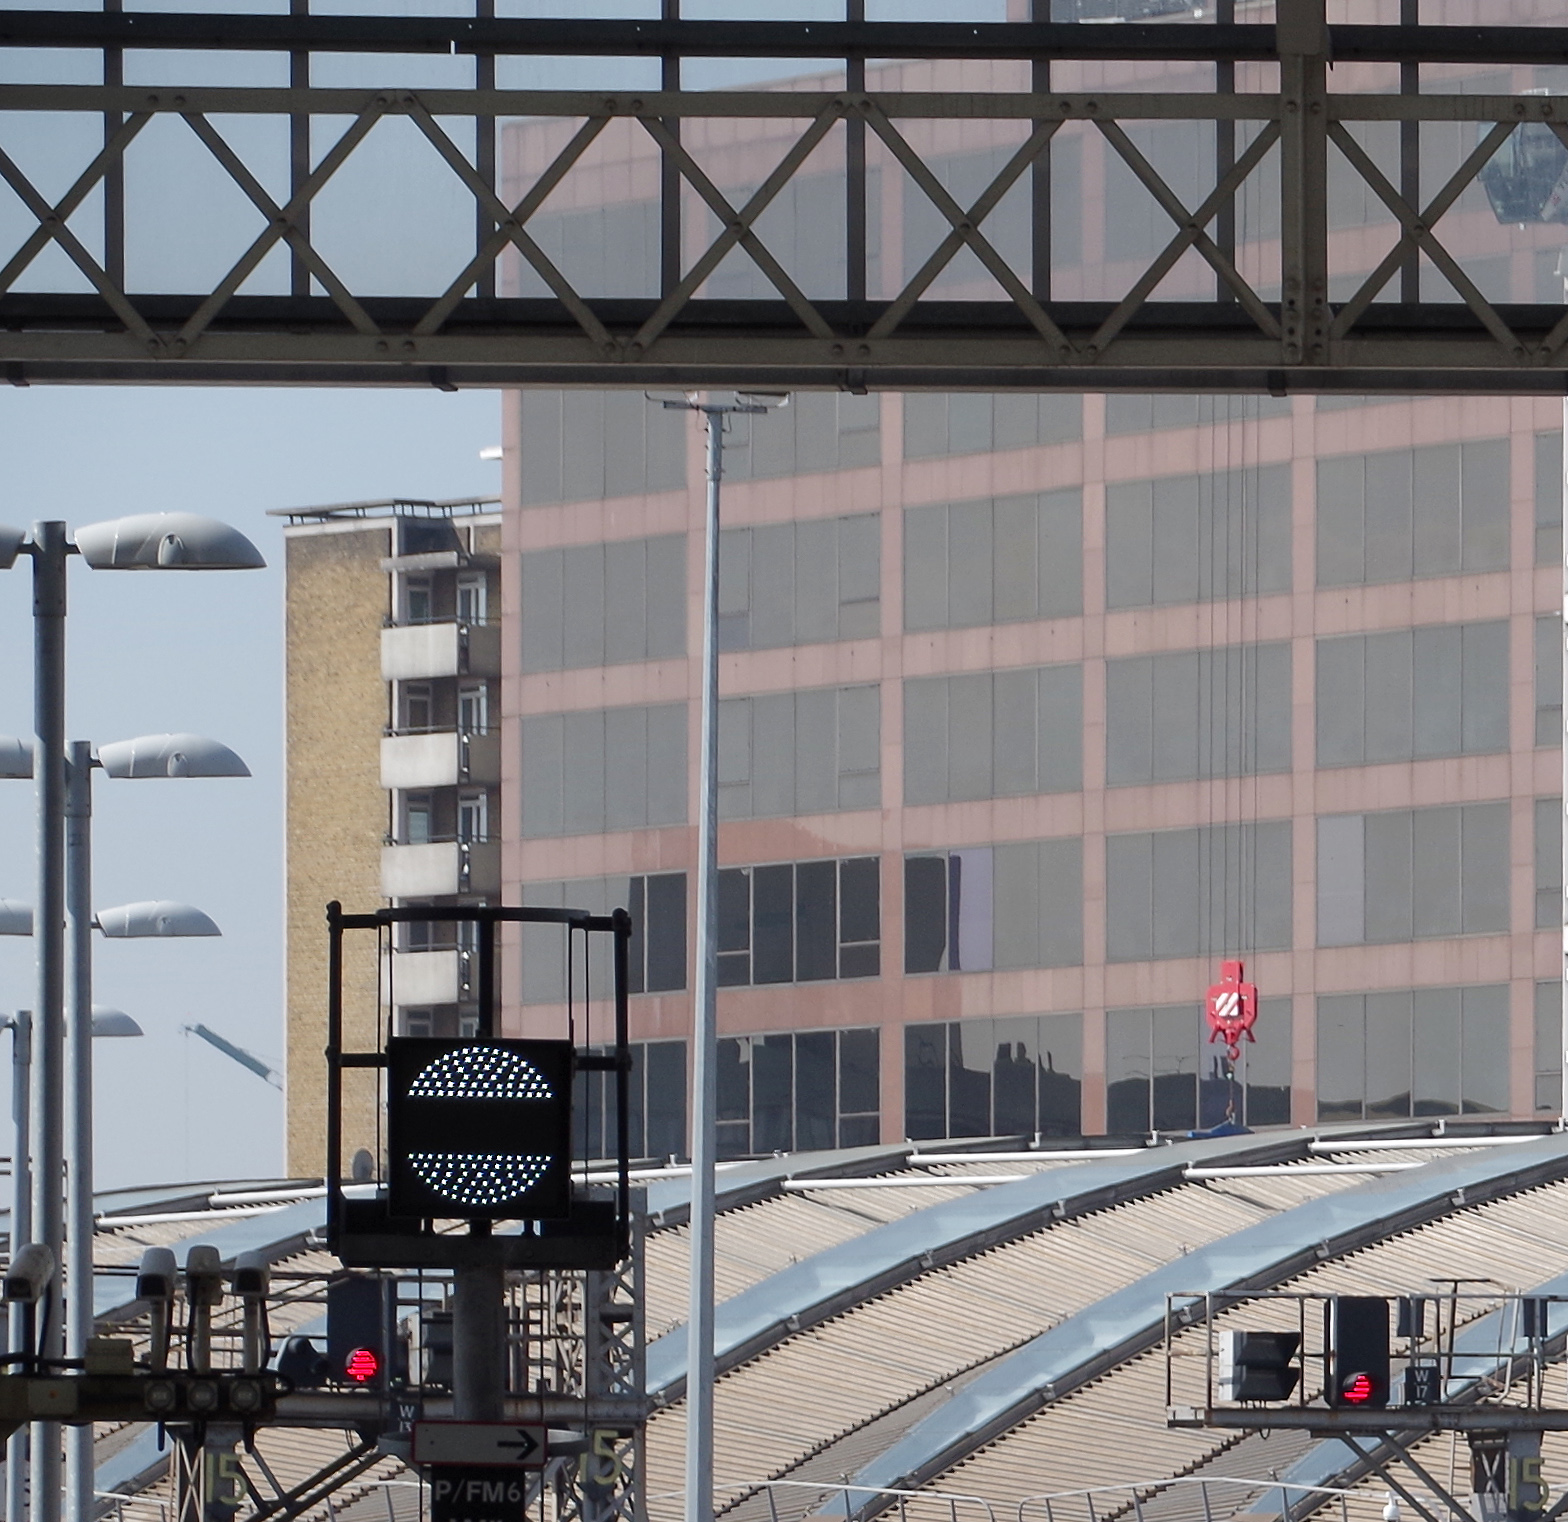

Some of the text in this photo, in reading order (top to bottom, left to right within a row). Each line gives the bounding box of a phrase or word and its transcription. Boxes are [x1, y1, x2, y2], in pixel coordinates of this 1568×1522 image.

[1415, 1369, 1429, 1382] W
[1416, 1385, 1428, 1399] 17
[206, 1453, 248, 1505] 15
[434, 1479, 521, 1503] P/FM6
[1509, 1457, 1550, 1512] 15
